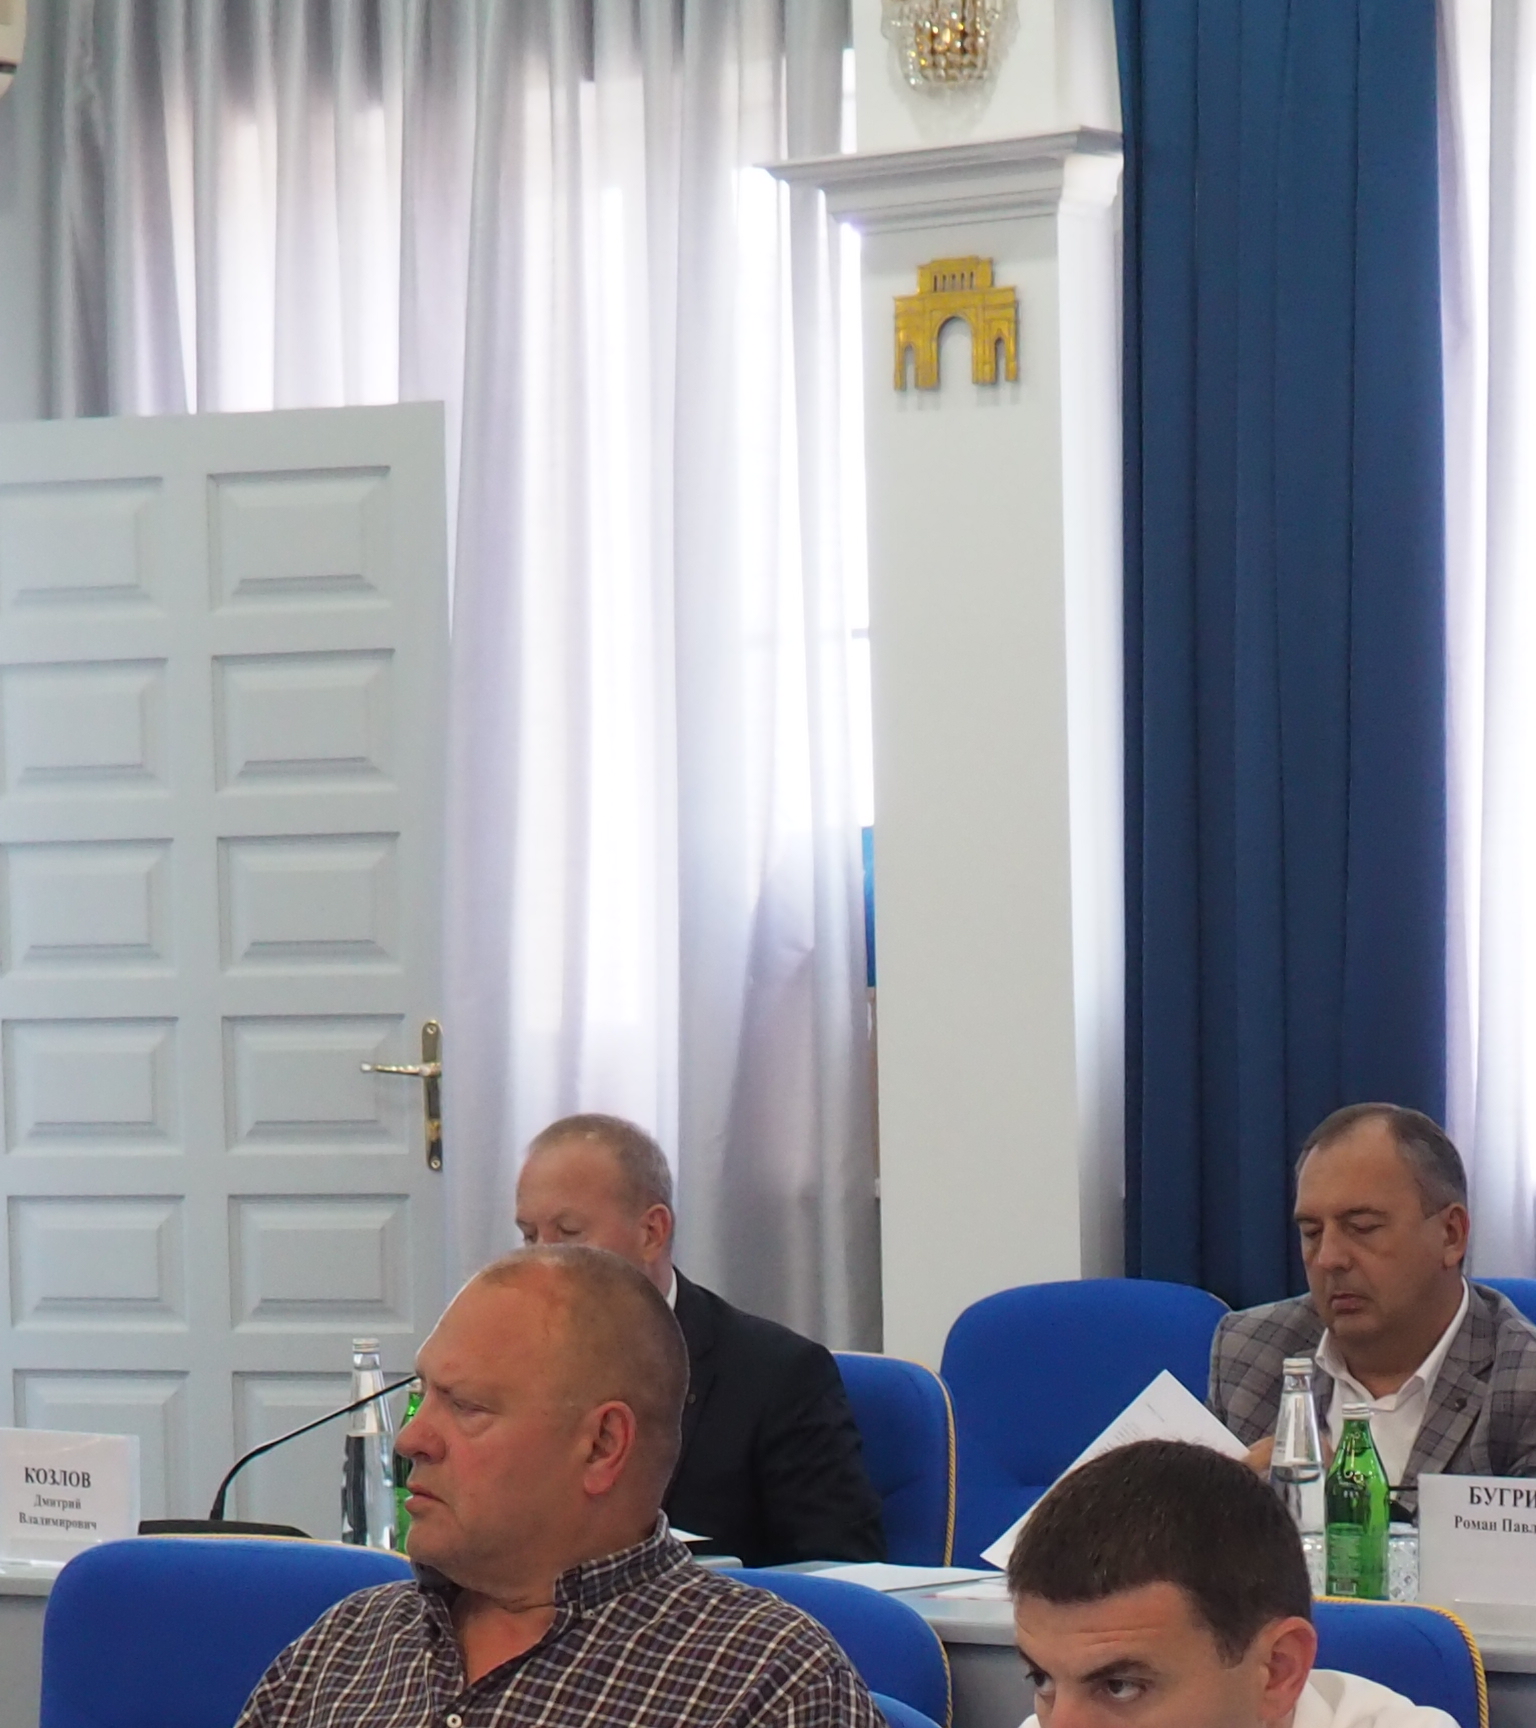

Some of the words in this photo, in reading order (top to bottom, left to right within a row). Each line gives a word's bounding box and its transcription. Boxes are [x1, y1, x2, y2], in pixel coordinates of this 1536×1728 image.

[24, 1466, 92, 1489] КОЗЛОВ
[33, 1494, 82, 1511] Дмитрий
[18, 1511, 97, 1531] Владимирович
[1454, 1515, 1497, 1531] Роман
